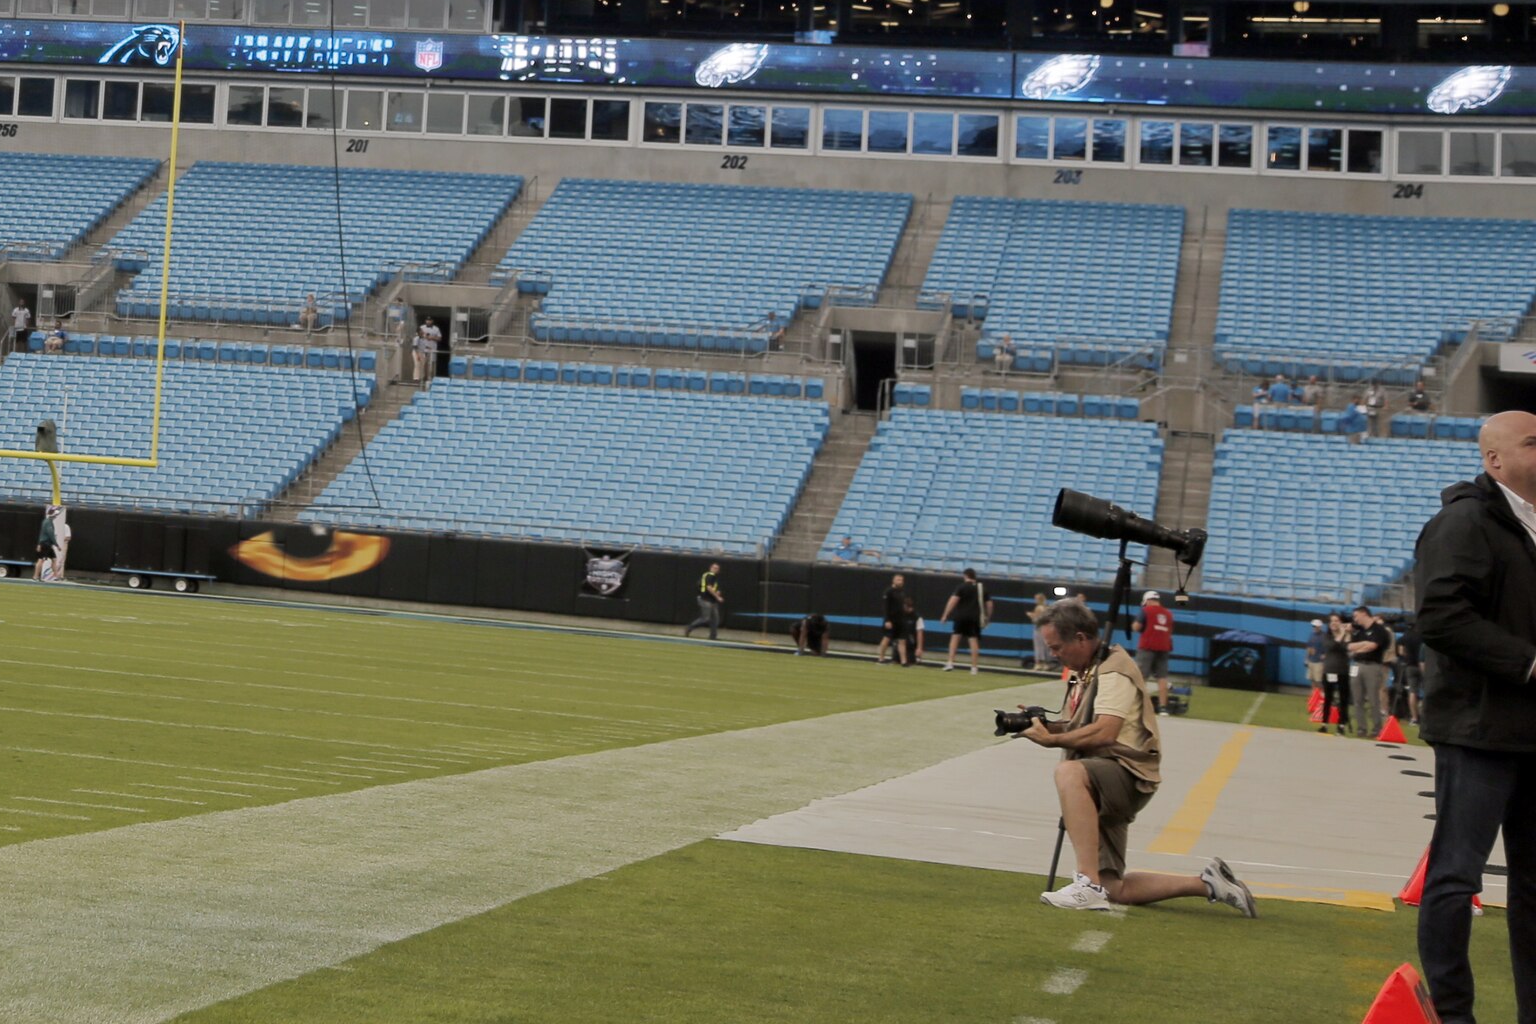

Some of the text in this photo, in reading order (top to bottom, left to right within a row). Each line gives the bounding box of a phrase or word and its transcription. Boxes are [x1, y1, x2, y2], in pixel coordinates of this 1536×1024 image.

[419, 54, 439, 67] NFL
[346, 139, 369, 153] 201
[721, 155, 748, 170] 202
[1053, 170, 1083, 184] 203
[1393, 184, 1424, 199] 204
